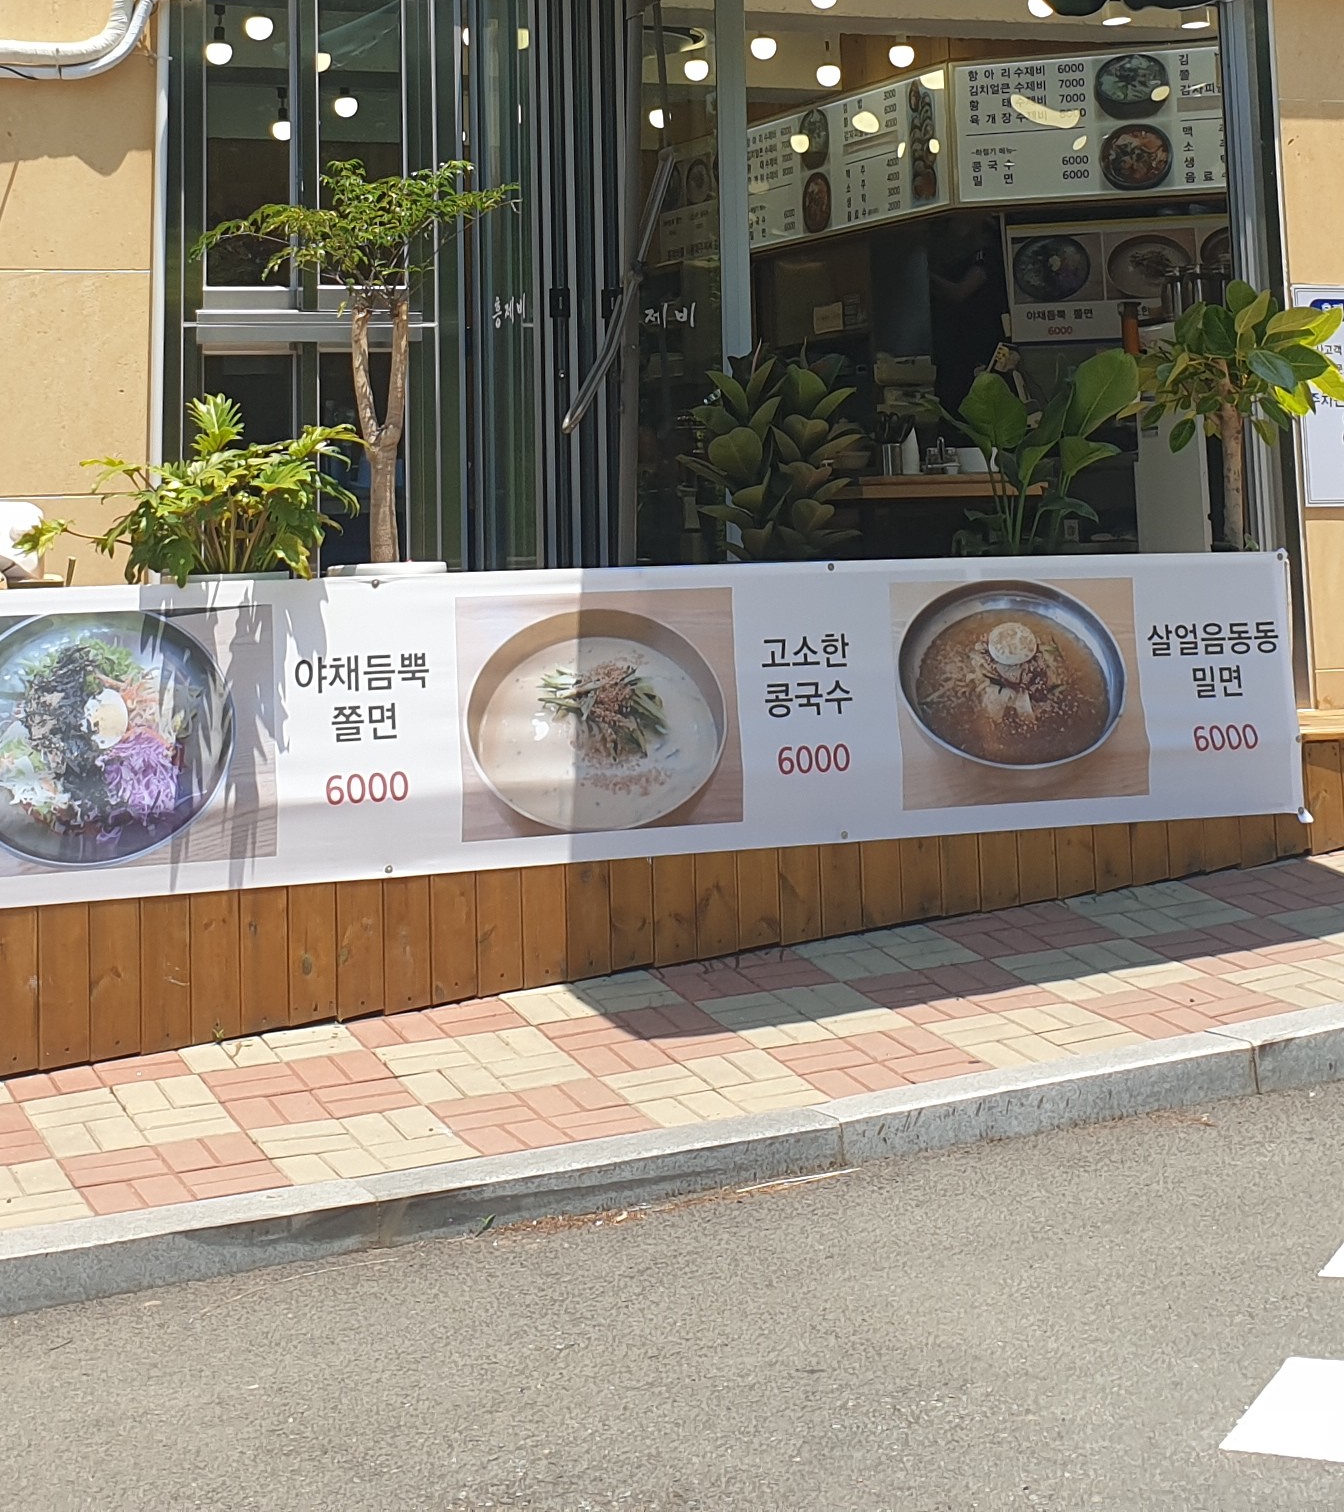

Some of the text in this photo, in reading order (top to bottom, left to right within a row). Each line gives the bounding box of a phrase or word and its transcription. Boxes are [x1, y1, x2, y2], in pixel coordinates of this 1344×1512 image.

[1057, 63, 1084, 74] 6000
[969, 78, 1085, 97] 김치얼큰 수제비 7000
[1059, 93, 1086, 104] 7000
[1062, 155, 1089, 166] 6000
[1062, 169, 1090, 180] 6000
[1047, 325, 1073, 337] 6000
[761, 632, 850, 669] 고소한
[1147, 621, 1279, 657] 살얼음동동
[295, 652, 430, 694] 야채듬뿍
[1191, 664, 1244, 699] 밀면
[764, 679, 853, 718] 콩국수
[331, 702, 398, 743] 쫄면
[1193, 723, 1259, 752] 6000
[777, 743, 851, 775] 6000
[325, 770, 409, 806] 6000
